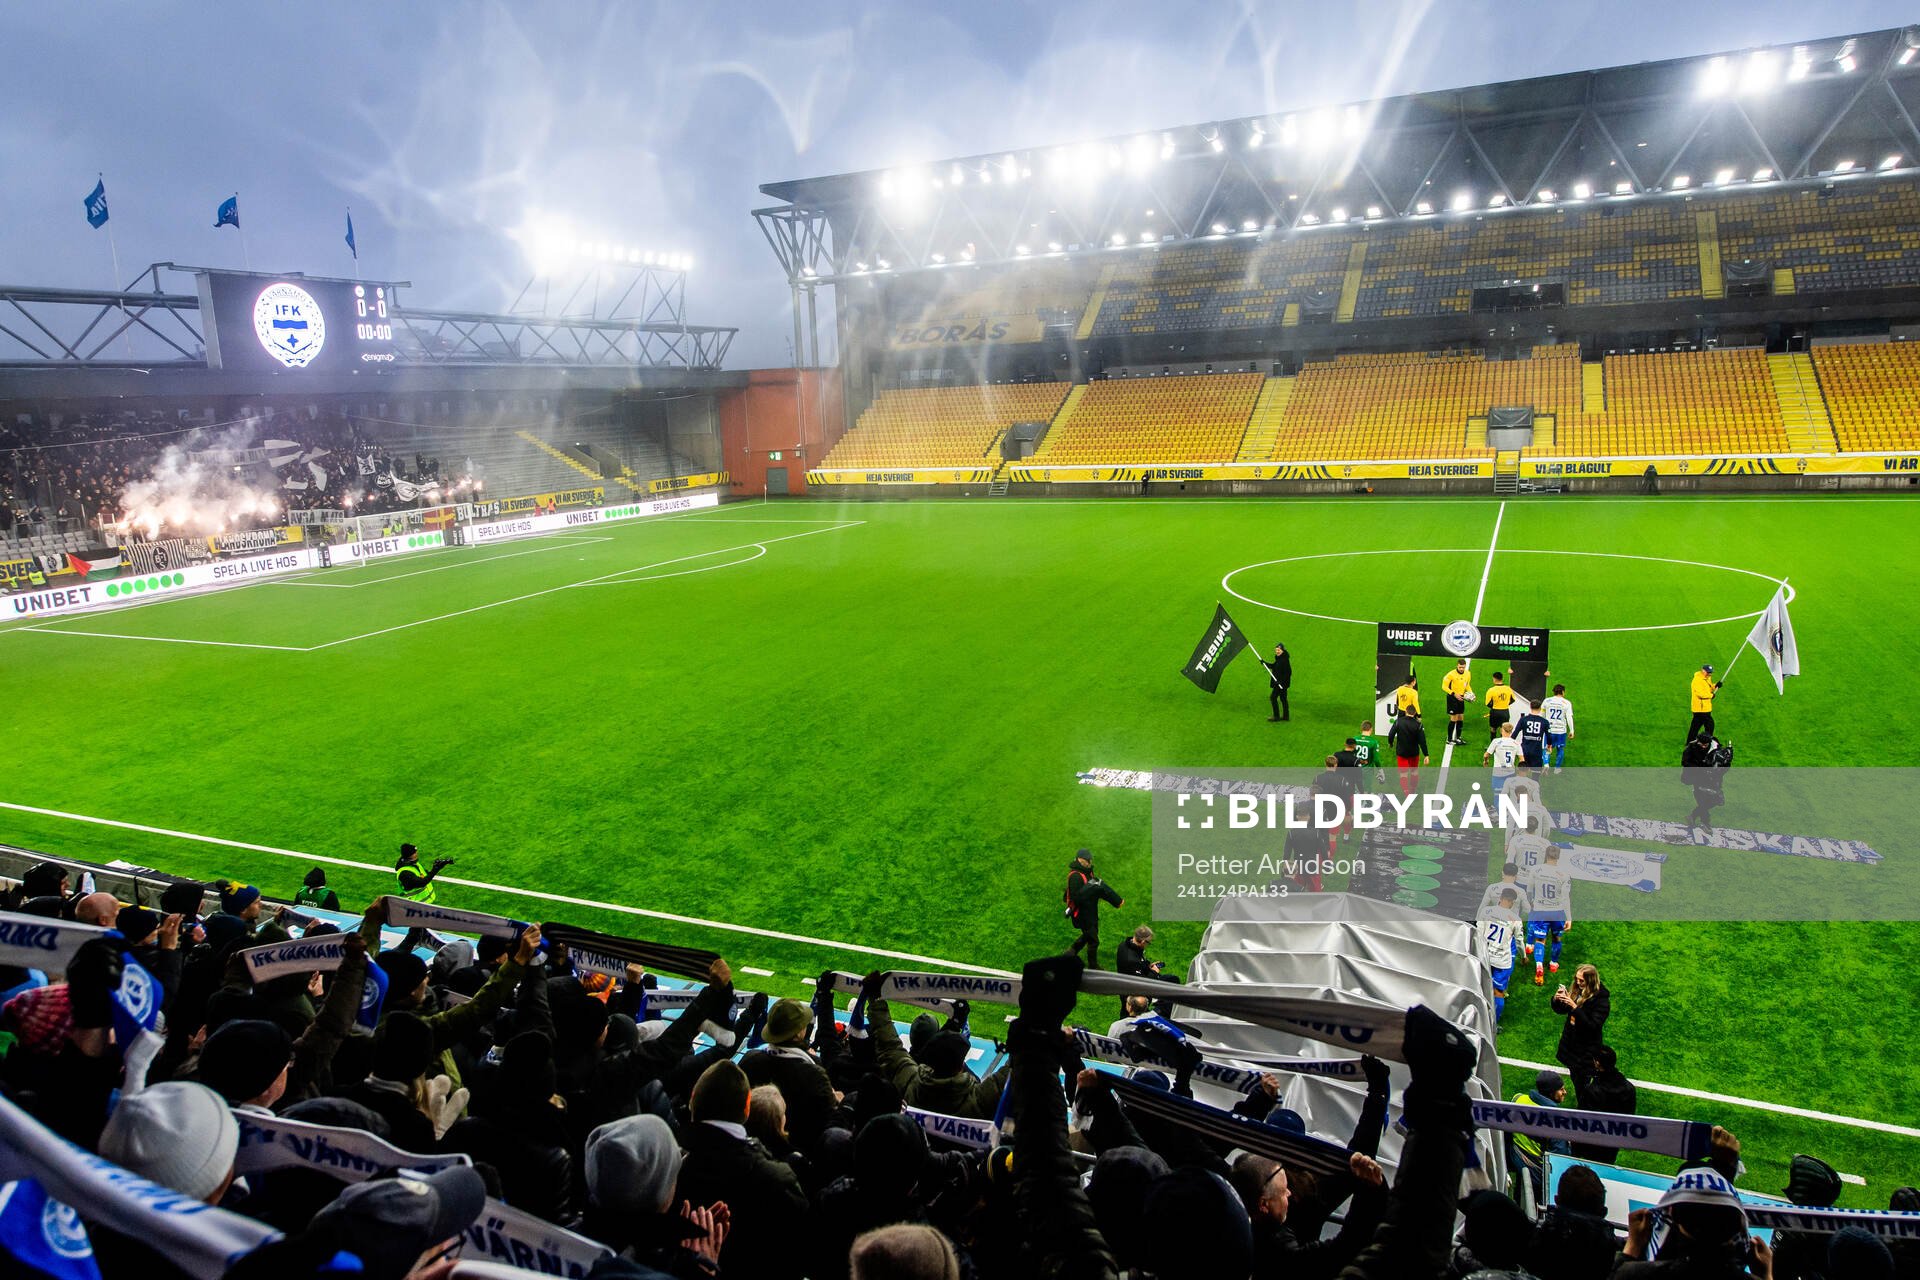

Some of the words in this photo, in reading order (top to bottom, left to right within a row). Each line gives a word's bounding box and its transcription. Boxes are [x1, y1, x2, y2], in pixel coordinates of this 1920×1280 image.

[275, 304, 302, 316] IFK
[357, 324, 392, 340] 00:00
[897, 318, 1010, 345] BORÅS
[1408, 465, 1432, 476] HEJA
[1433, 464, 1479, 476] SVERIGE!
[1565, 461, 1612, 475] BLÅGULT
[1884, 458, 1897, 470] VI
[866, 473, 882, 482] HEJA
[883, 473, 914, 482] SVERIGE!
[1169, 469, 1204, 479] SVERIGE
[571, 490, 596, 502] SVERIGE
[566, 510, 599, 524] UNIBET
[478, 525, 500, 537] SPELA
[502, 523, 517, 534] LIVE
[518, 520, 532, 531] HOS
[352, 538, 400, 557] UNIBET
[213, 562, 248, 579] SPELA
[250, 559, 272, 573] LIVE
[276, 555, 298, 568] HOS
[13, 587, 92, 613] UNIBET
[1386, 629, 1432, 642] UNIBET
[1490, 634, 1540, 646] UNIBET
[1550, 708, 1563, 721] 22
[1526, 721, 1542, 734] 39
[1355, 745, 1369, 760] 29
[1505, 751, 1512, 764] 5
[1524, 850, 1538, 867] 15
[1541, 883, 1556, 899] 16
[1487, 923, 1505, 944] 21
[251, 949, 276, 968] IFK
[893, 976, 921, 989] IFK
